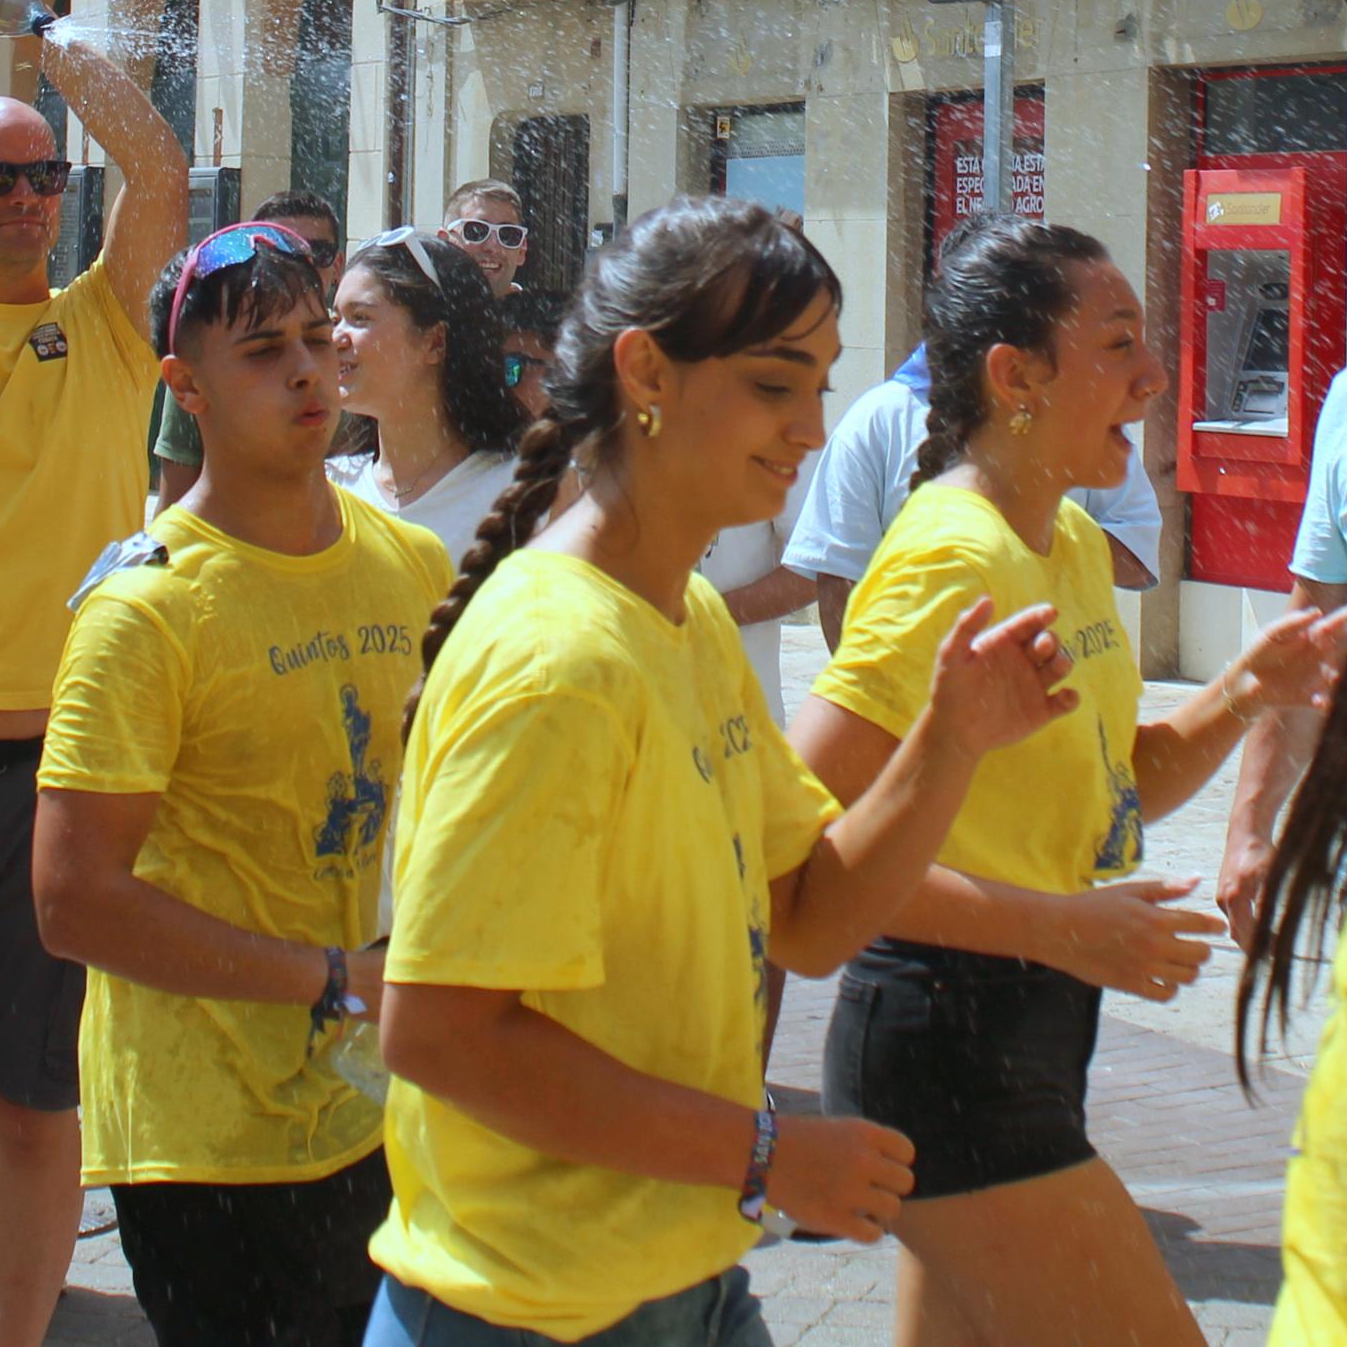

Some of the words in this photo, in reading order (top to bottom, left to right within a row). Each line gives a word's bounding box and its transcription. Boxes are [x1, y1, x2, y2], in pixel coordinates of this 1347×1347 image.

[956, 155, 982, 174] ESTA
[956, 197, 969, 214] EL
[1015, 196, 1045, 213] AGRO
[268, 630, 351, 676] Quintos
[357, 623, 413, 656] 2025
